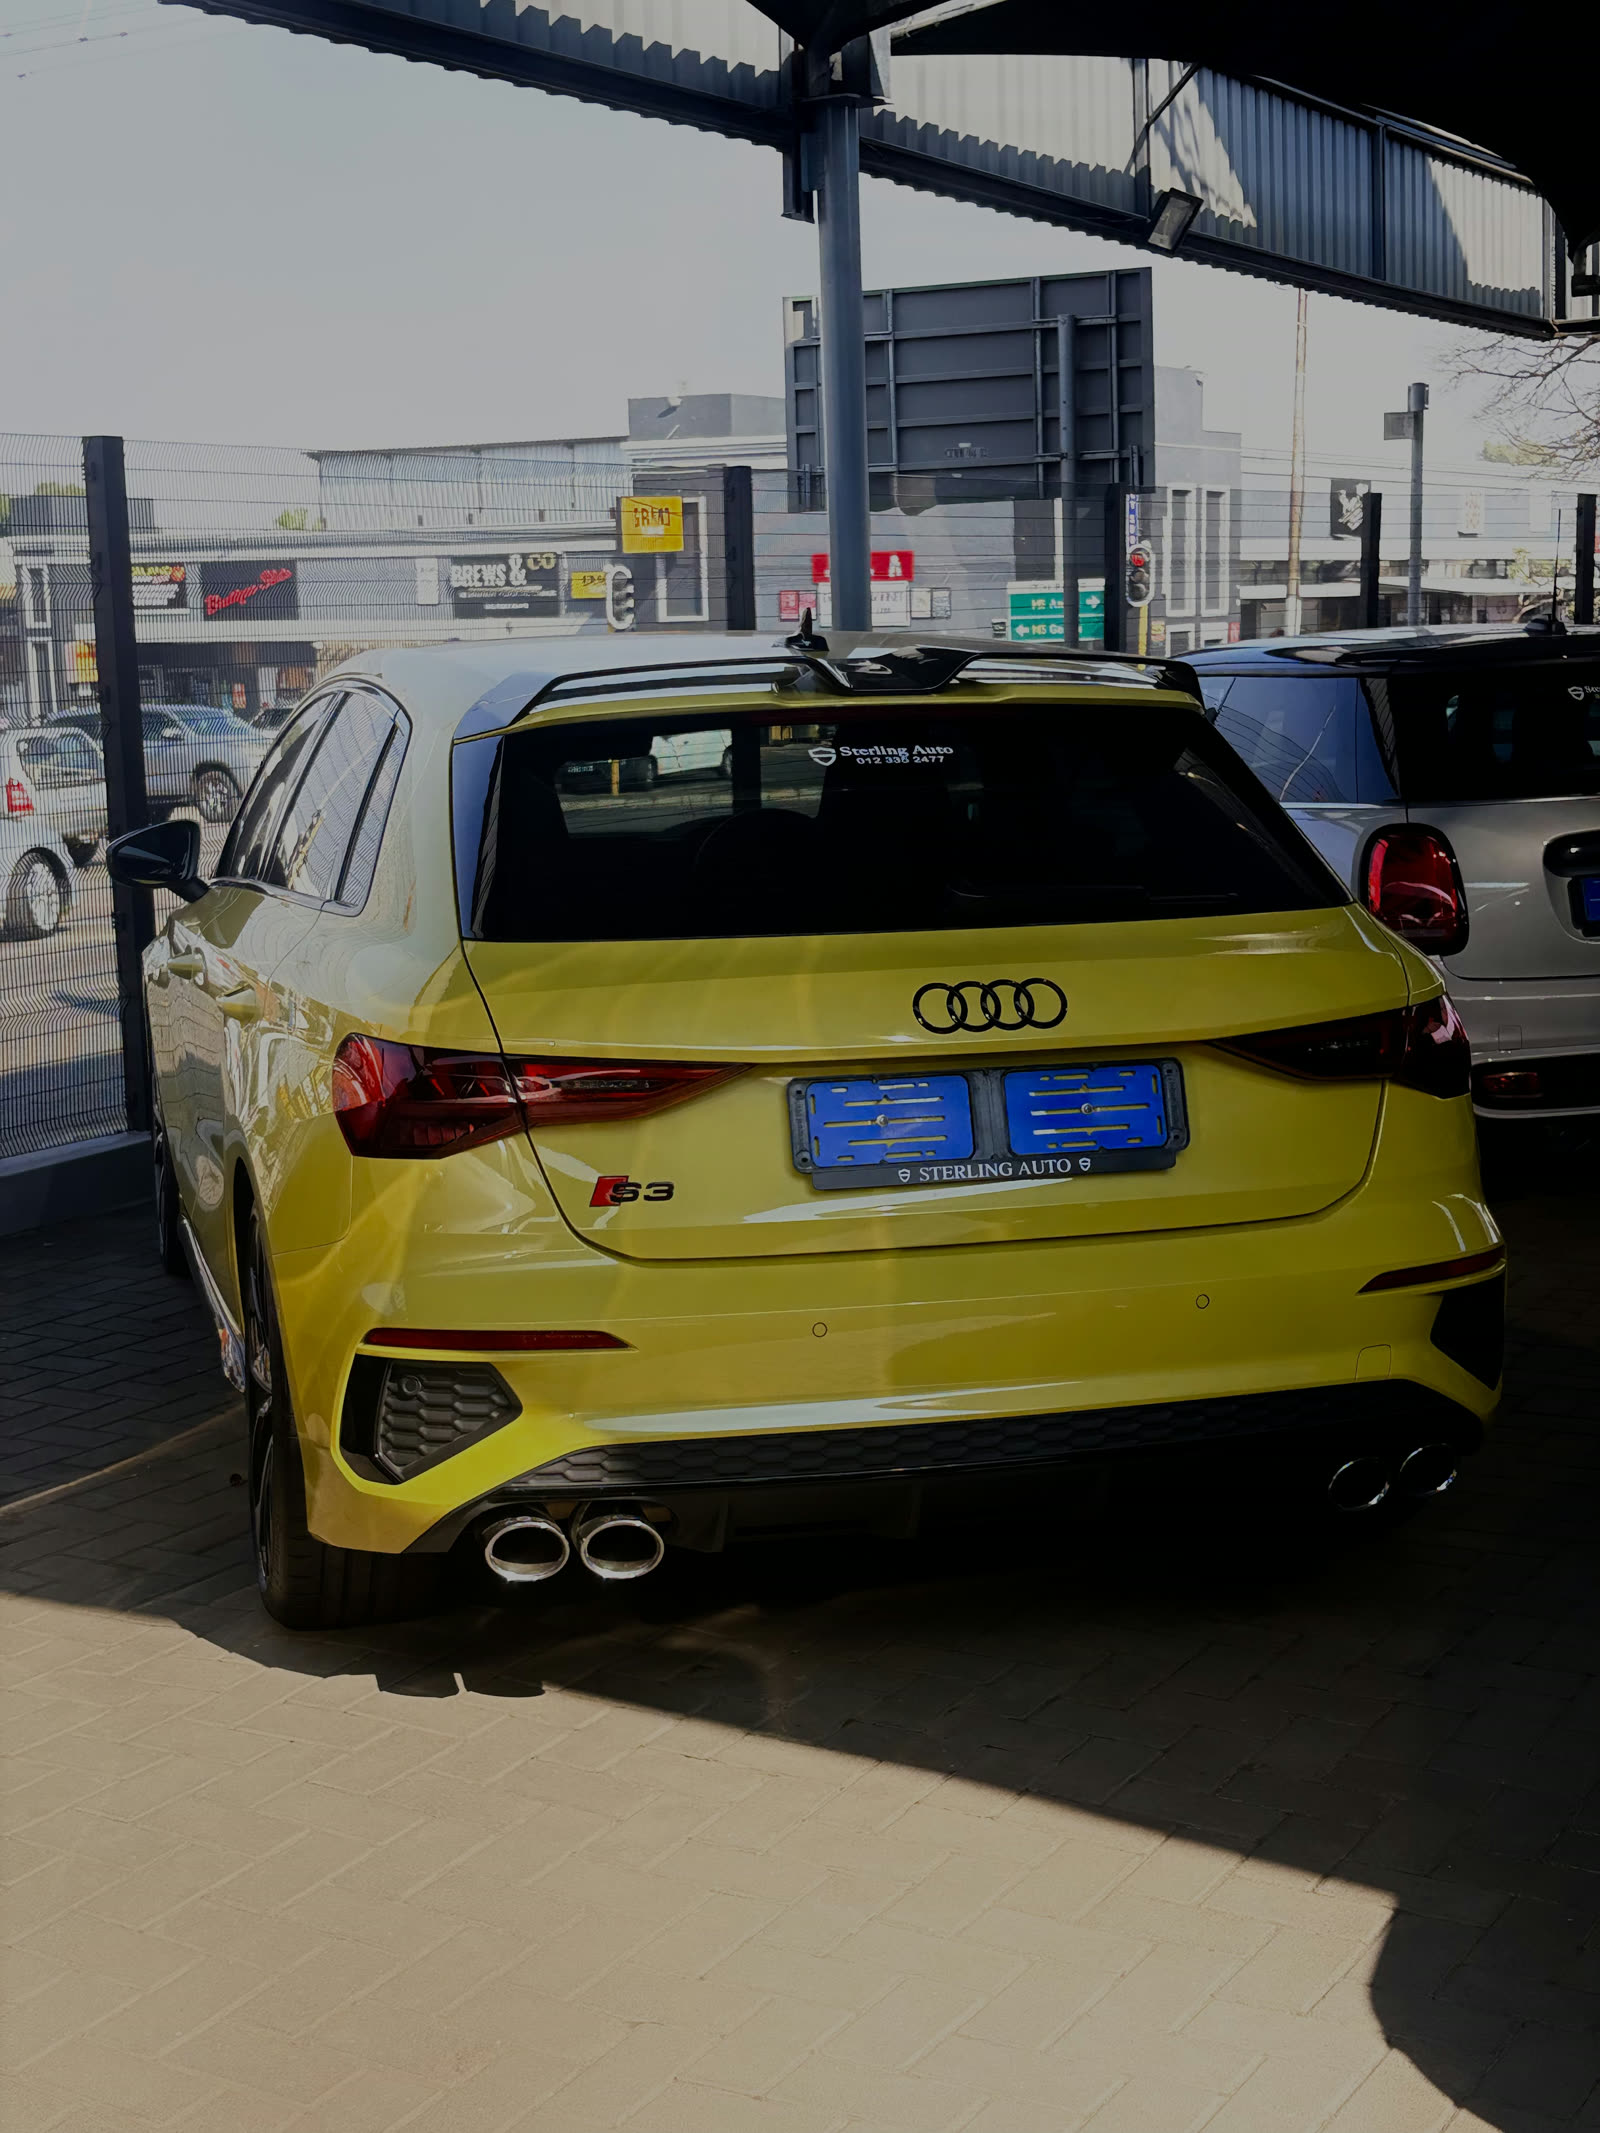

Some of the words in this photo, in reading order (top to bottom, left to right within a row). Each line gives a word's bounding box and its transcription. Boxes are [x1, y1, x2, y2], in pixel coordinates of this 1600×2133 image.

[451, 563, 506, 587] BREWS
[839, 746, 908, 757] Sterling
[912, 745, 953, 755] Auto
[912, 755, 944, 763] 2477
[919, 1162, 1013, 1181] STERLING
[1018, 1158, 1071, 1176] AUTO
[608, 1181, 675, 1203] S3
